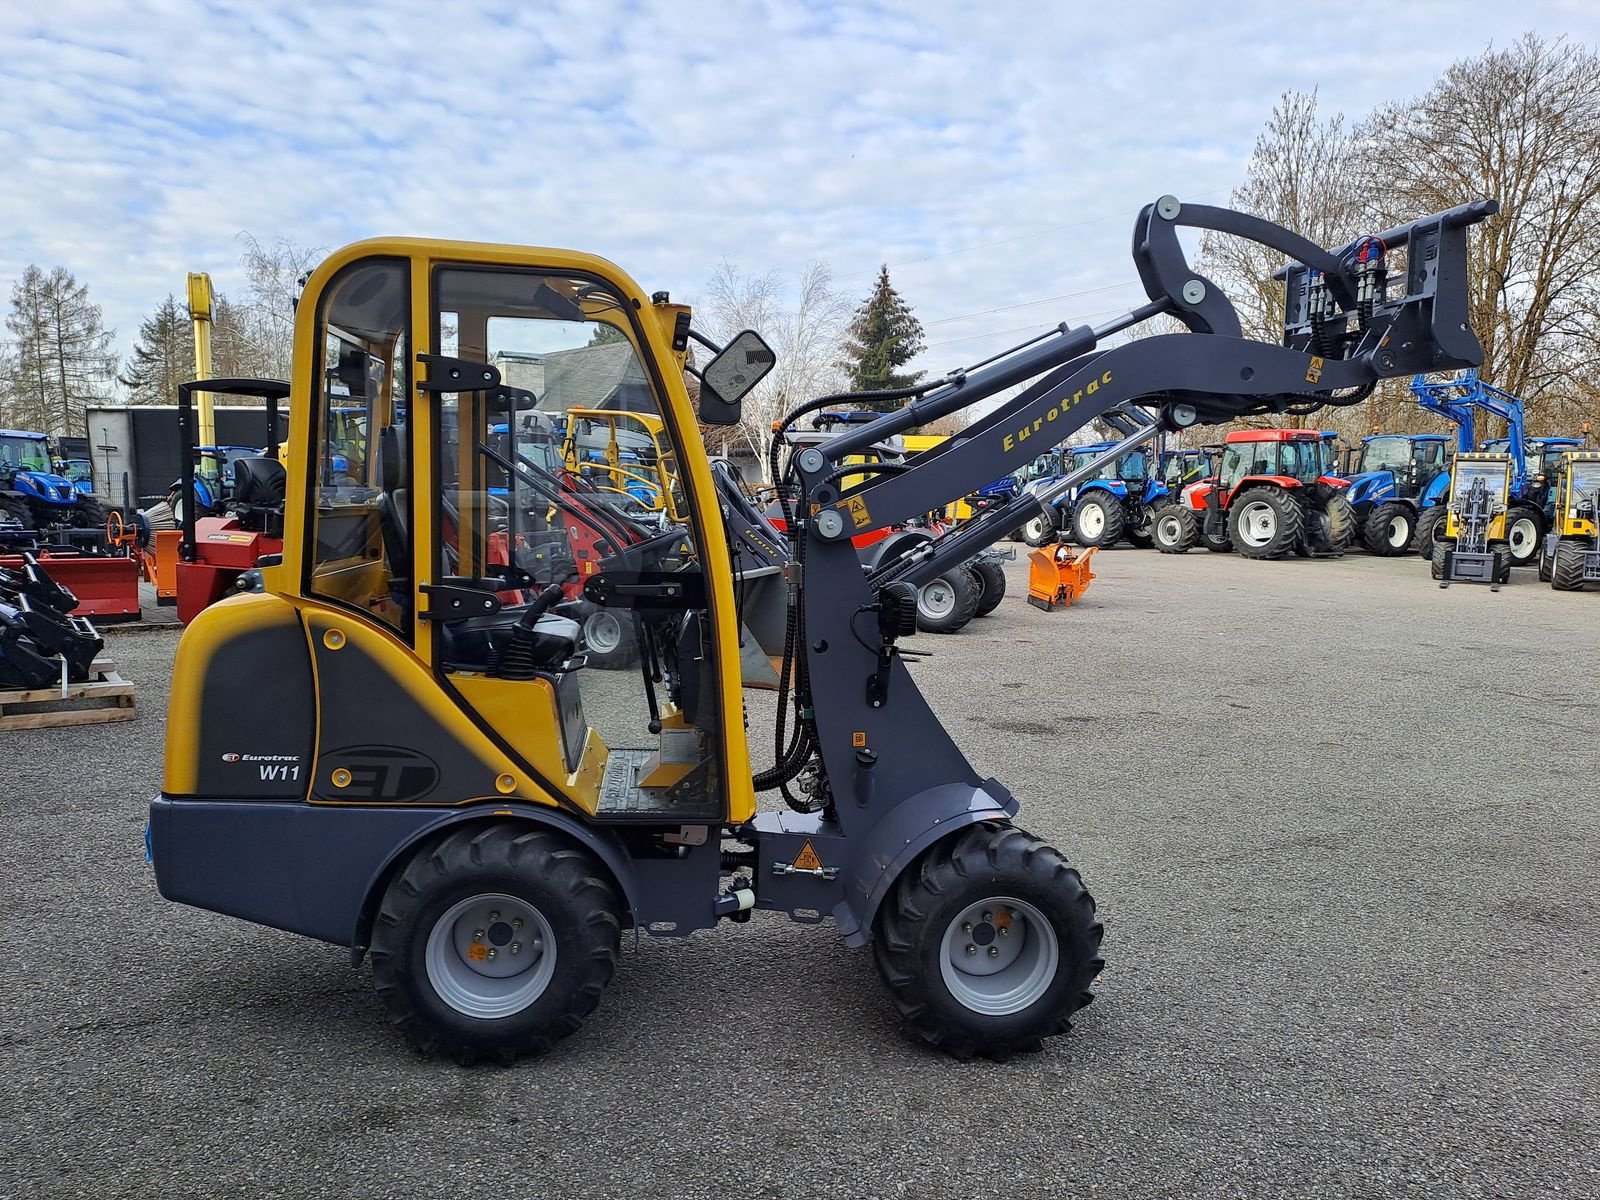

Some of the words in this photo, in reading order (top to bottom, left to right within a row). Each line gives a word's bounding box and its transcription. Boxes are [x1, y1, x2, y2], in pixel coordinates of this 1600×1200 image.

[1002, 370, 1113, 452] Eurotrac
[745, 529, 778, 558] Eurotrac
[259, 765, 300, 781] W11
